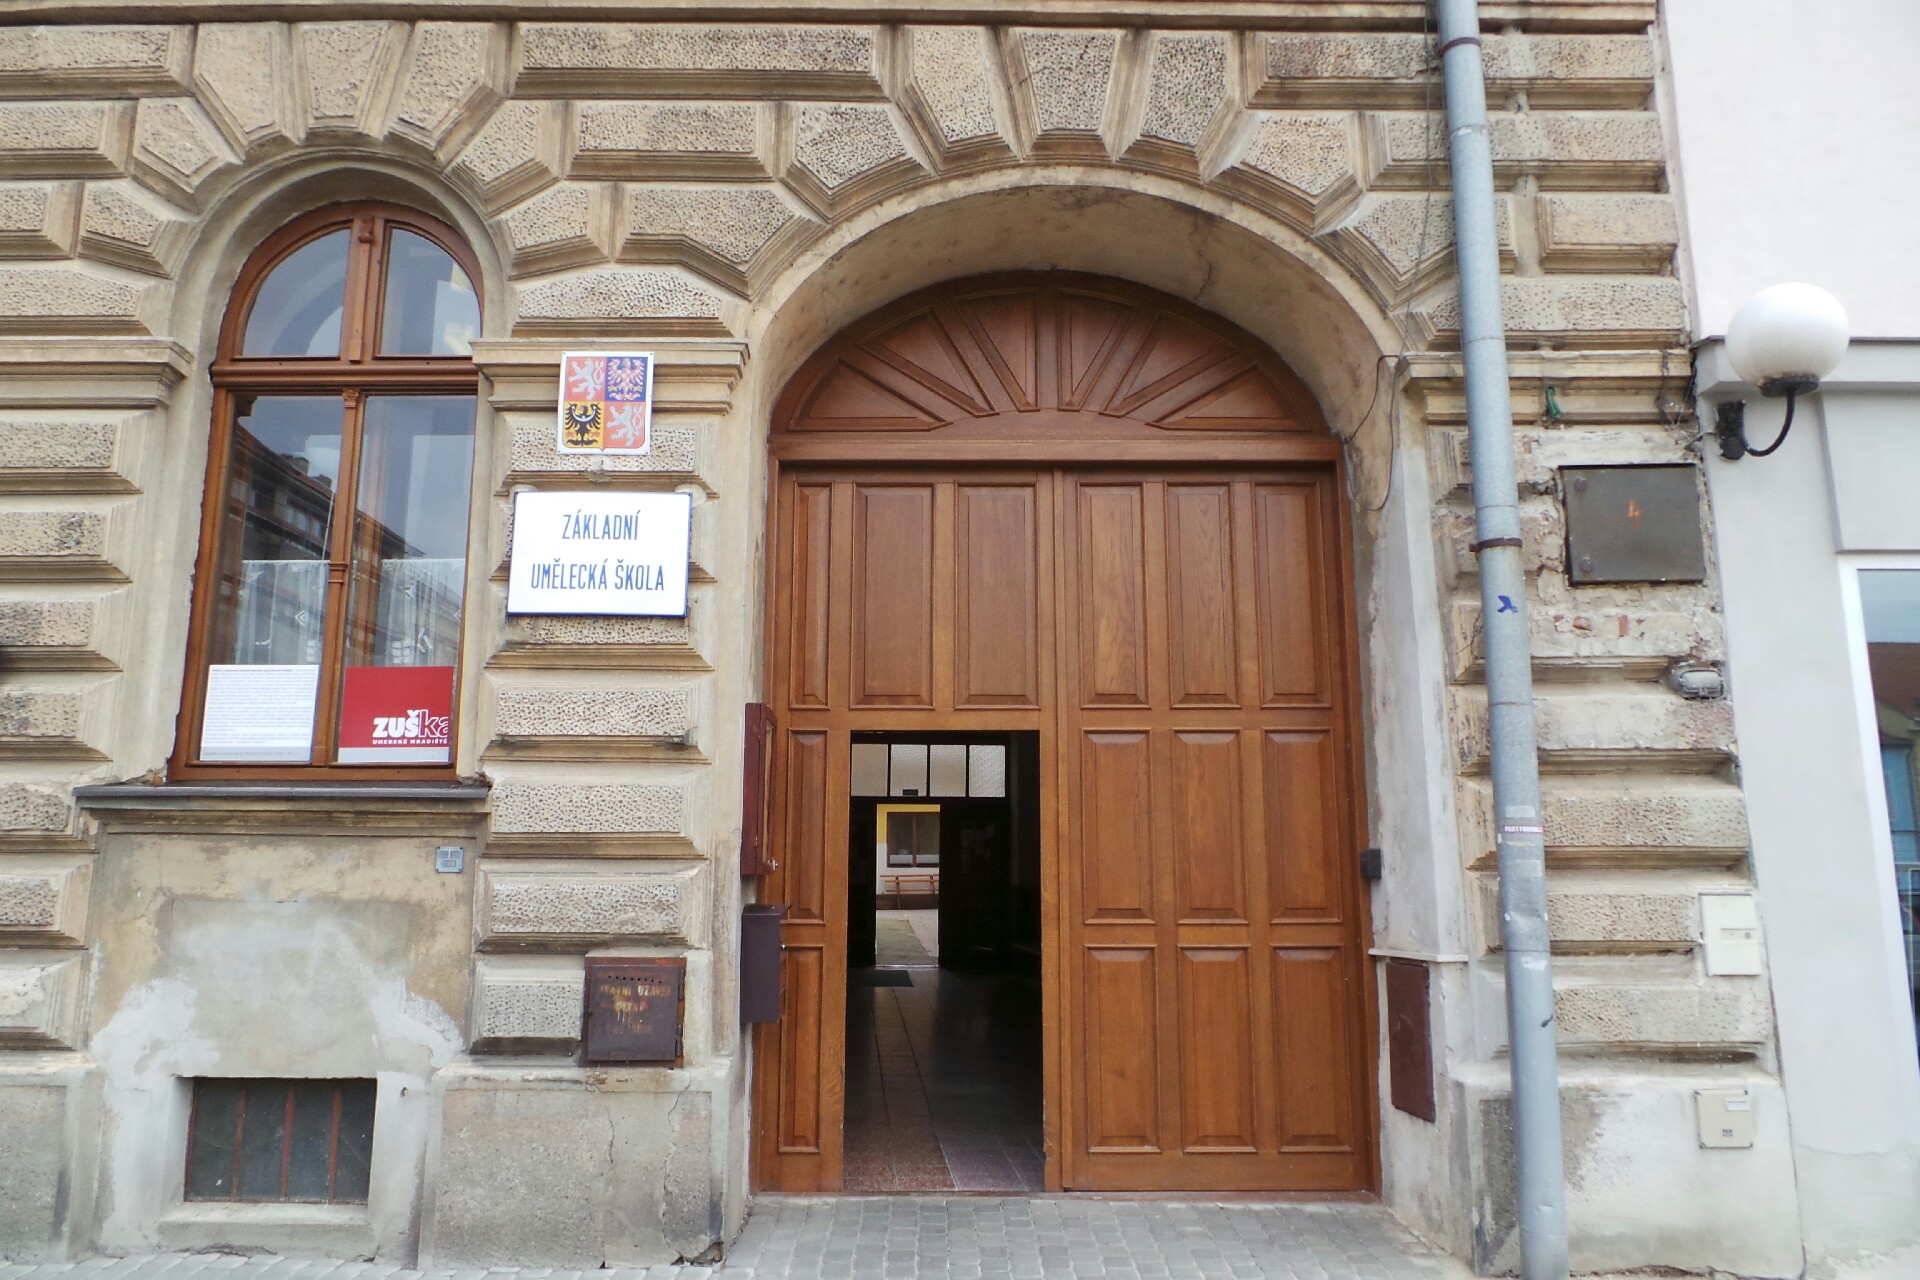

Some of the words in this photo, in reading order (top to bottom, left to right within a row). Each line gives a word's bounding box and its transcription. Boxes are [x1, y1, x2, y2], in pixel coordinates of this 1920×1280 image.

[562, 508, 642, 541] ZÁKLADNÍ
[1627, 498, 1642, 530] 4
[531, 557, 608, 590] UMĚLECKÁ
[614, 558, 665, 591] ŠKOLA
[409, 737, 448, 745] HRADIŠTĚ
